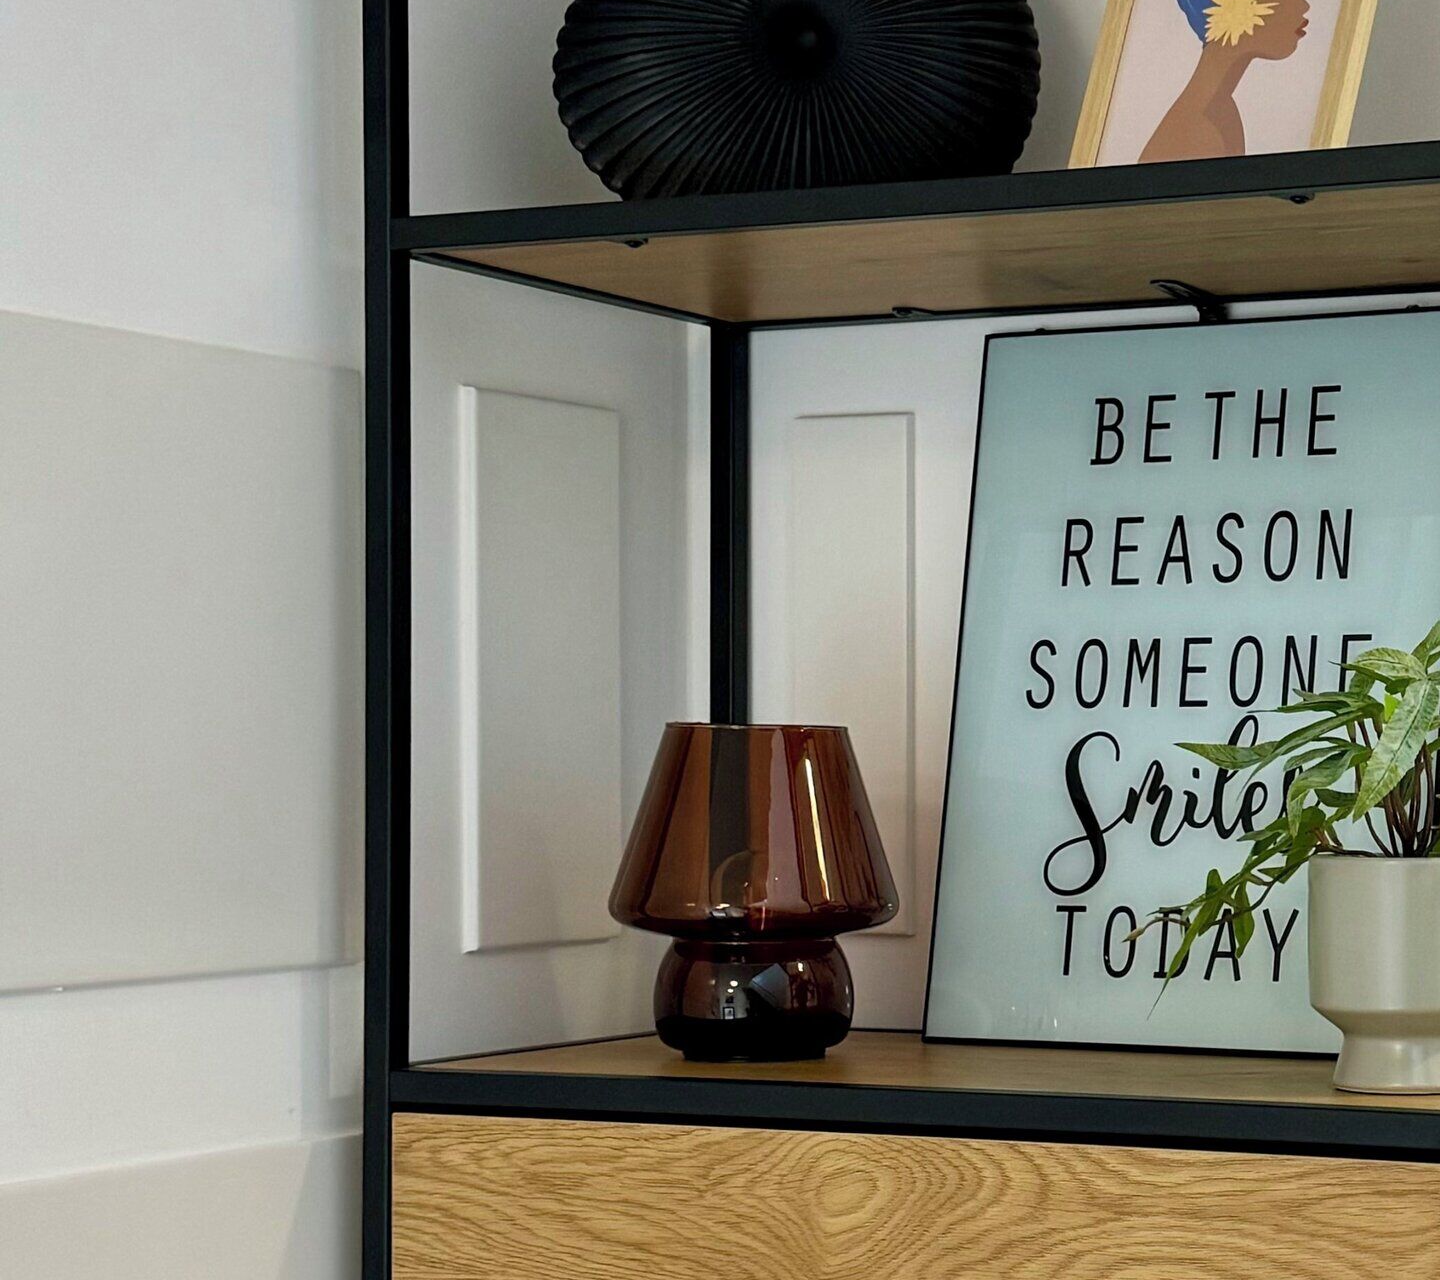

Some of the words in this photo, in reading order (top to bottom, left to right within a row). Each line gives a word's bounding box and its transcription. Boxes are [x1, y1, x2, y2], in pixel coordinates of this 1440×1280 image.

[1090, 394, 1176, 466] BE
[1204, 384, 1342, 461] THE
[1061, 508, 1353, 588] REASON
[1042, 714, 1320, 896] Smile
[1055, 904, 1299, 982] TODAY
